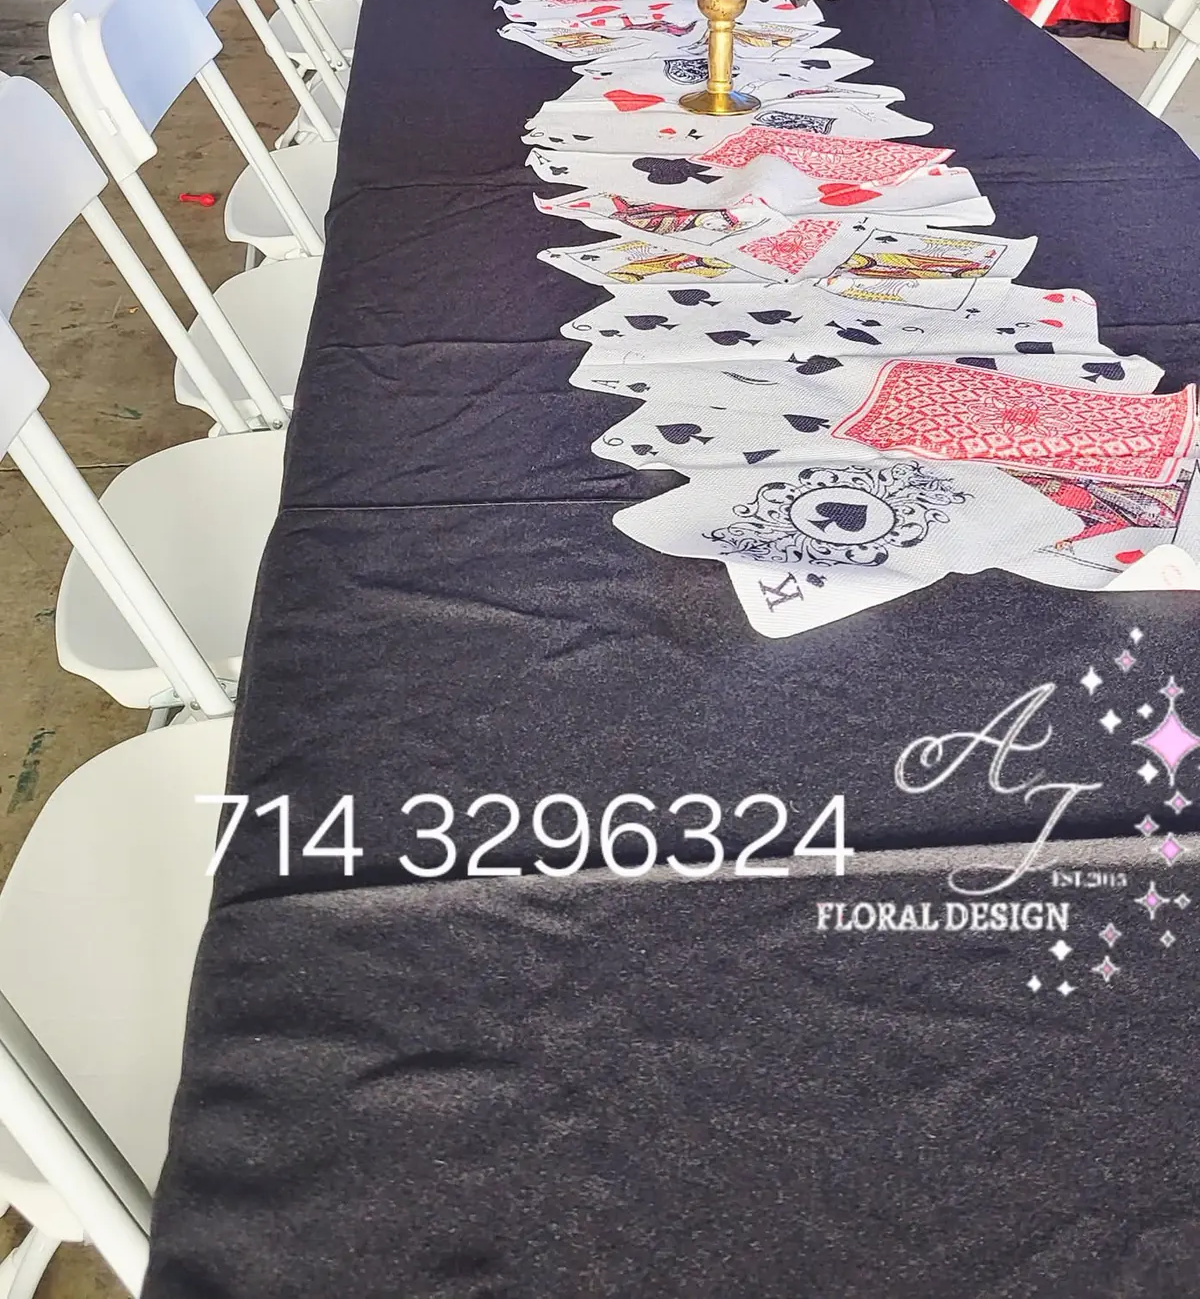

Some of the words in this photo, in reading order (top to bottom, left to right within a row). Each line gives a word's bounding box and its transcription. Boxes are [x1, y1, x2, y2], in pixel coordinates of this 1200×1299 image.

[533, 150, 551, 165] A
[591, 379, 620, 390] A
[758, 571, 804, 613] K
